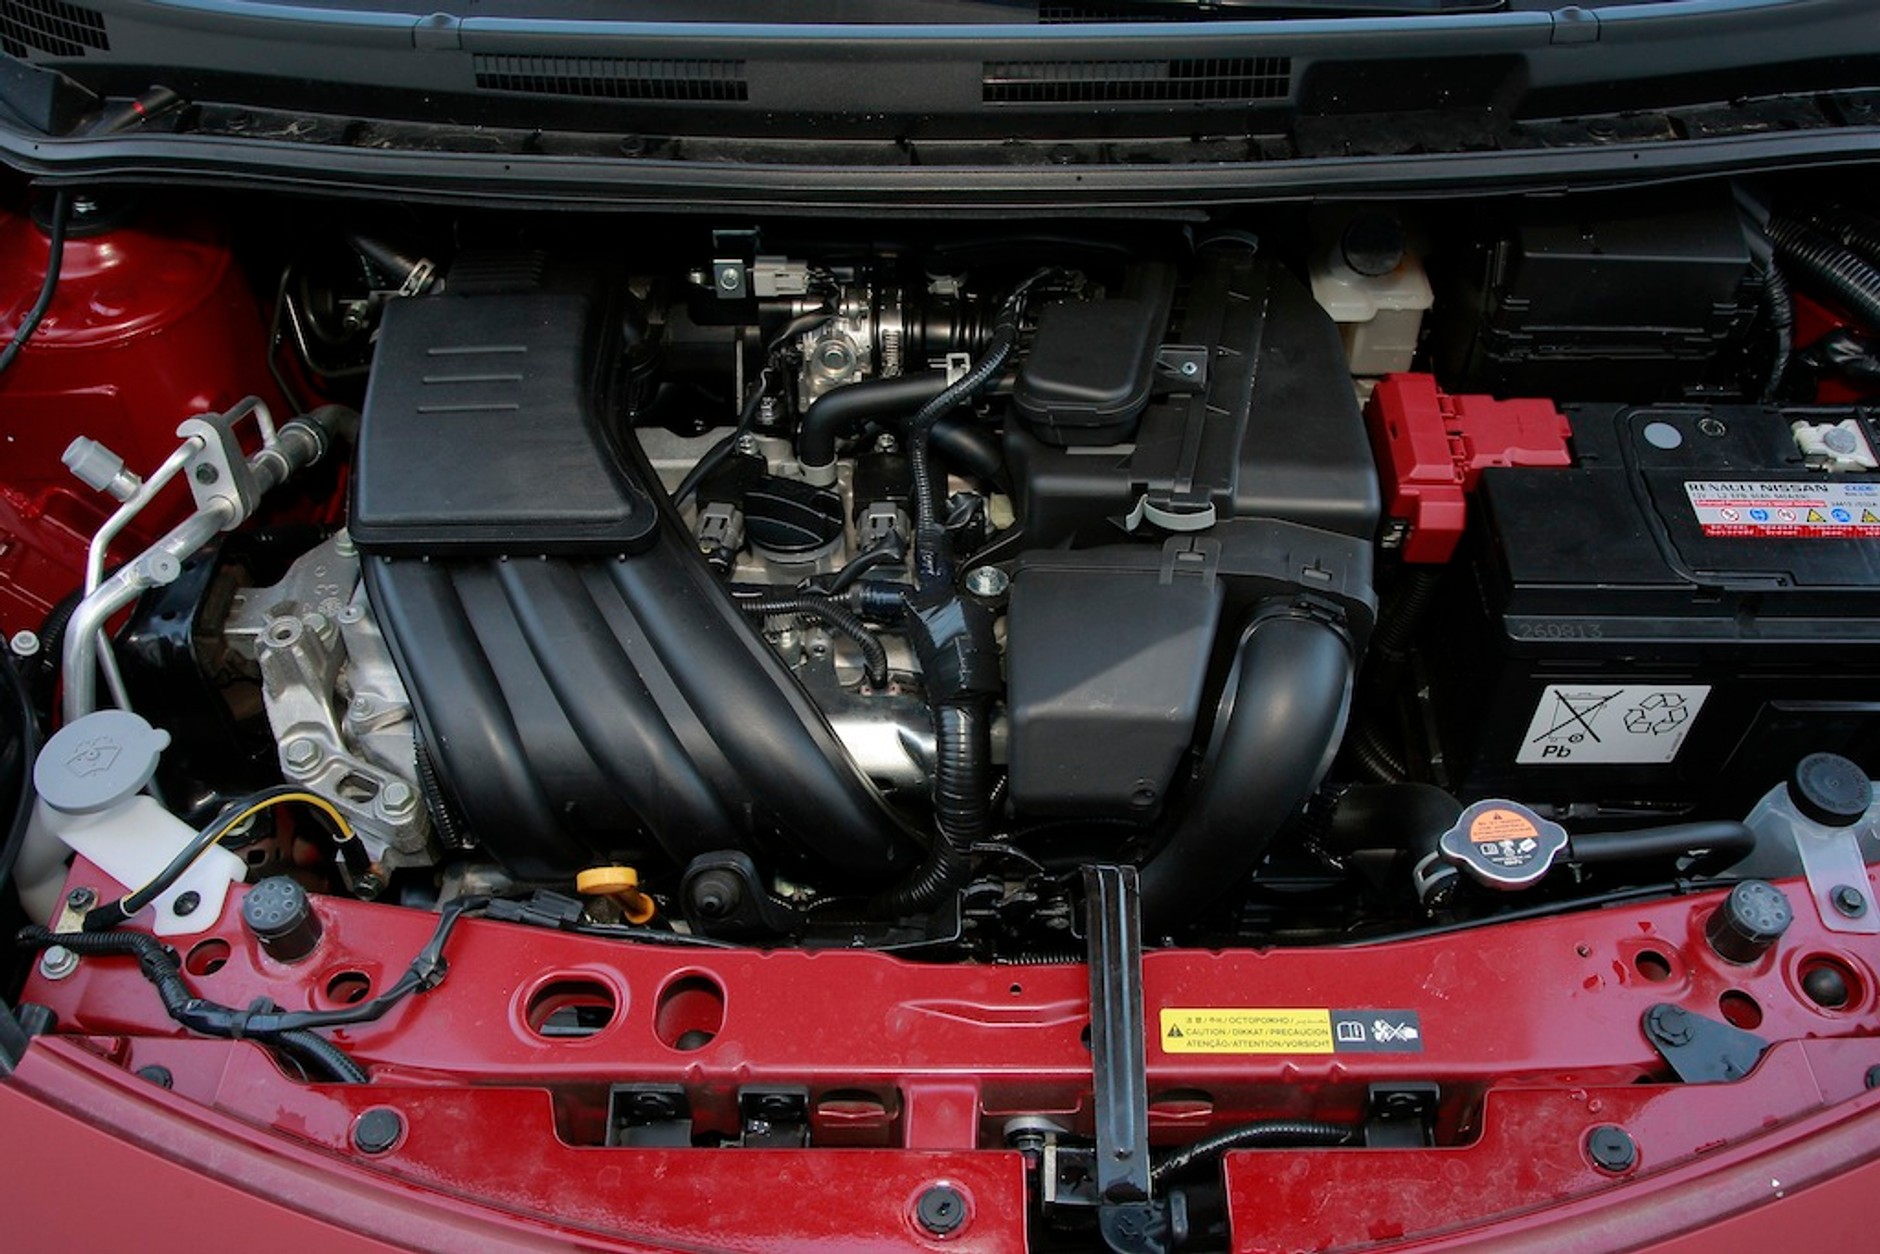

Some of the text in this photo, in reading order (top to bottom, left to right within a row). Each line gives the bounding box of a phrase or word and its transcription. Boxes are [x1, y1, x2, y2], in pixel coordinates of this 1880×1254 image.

[1688, 484, 1828, 492] RENAULT NISSAN
[1518, 623, 1603, 638] 260813
[1541, 745, 1571, 758] Pb
[1185, 1028, 1226, 1036] CAUTION
